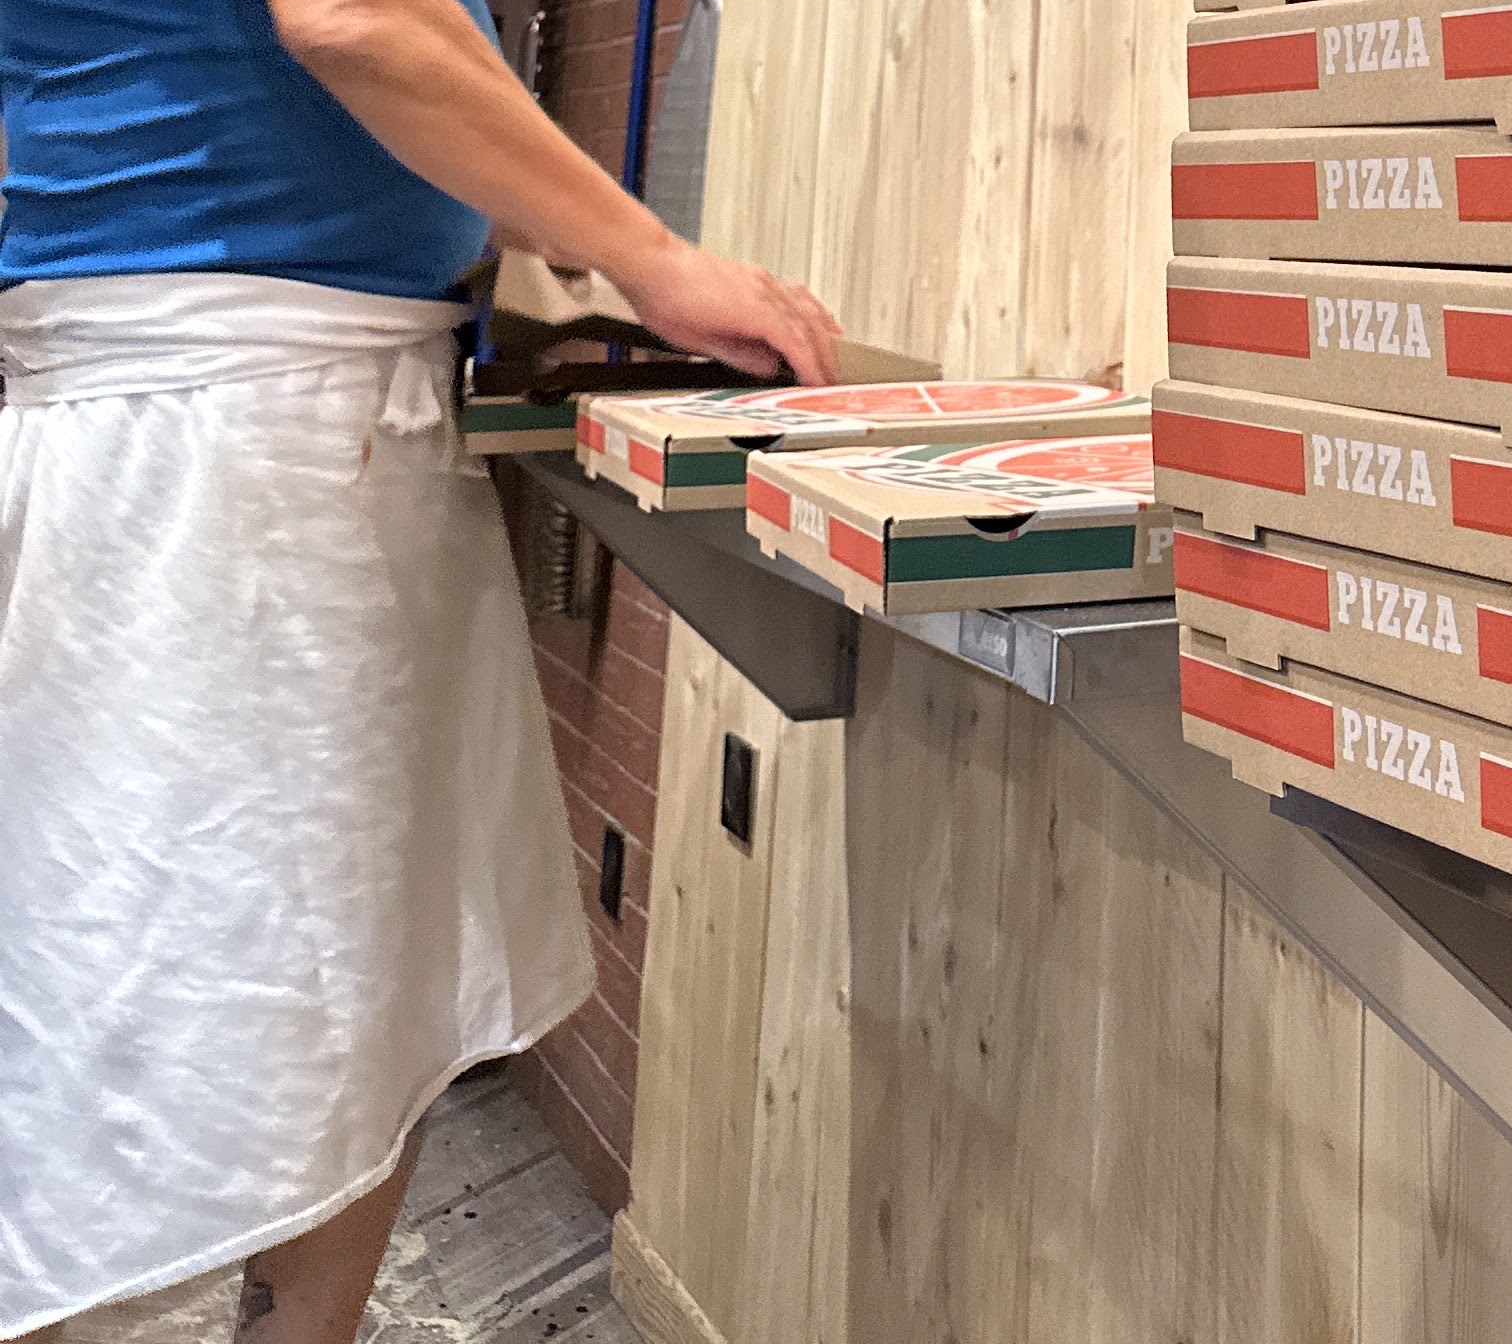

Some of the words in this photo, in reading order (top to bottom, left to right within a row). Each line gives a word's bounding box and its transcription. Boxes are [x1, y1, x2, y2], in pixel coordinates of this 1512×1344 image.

[1323, 15, 1430, 76] PIZZA
[1323, 157, 1443, 210] PIZZA
[1315, 295, 1431, 359] PIZZA
[1312, 433, 1437, 508] PIZZA
[1336, 570, 1462, 655] PIZZA
[1341, 705, 1465, 804] PIZZA
